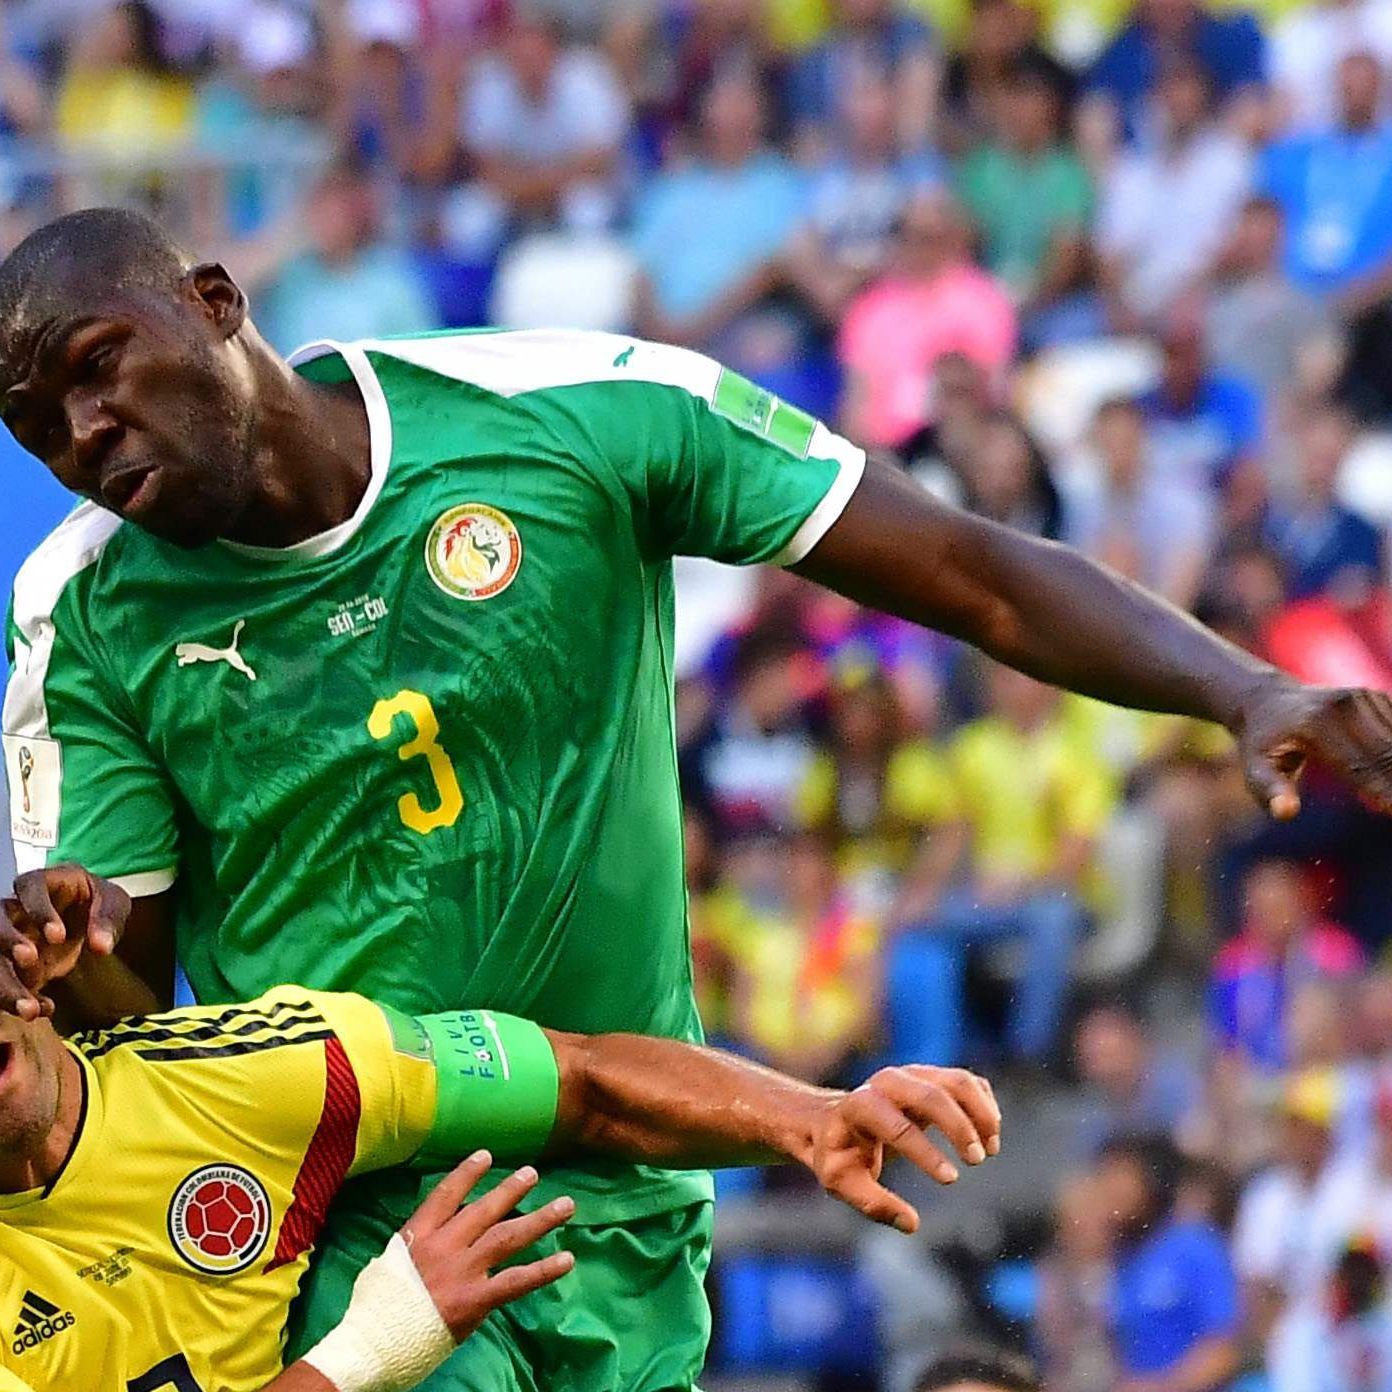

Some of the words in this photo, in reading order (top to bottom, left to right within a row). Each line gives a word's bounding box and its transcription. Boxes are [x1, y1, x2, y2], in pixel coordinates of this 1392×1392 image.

[367, 690, 464, 834] 3
[459, 1012, 495, 1079] FOOTB
[12, 1311, 76, 1356] adidas
